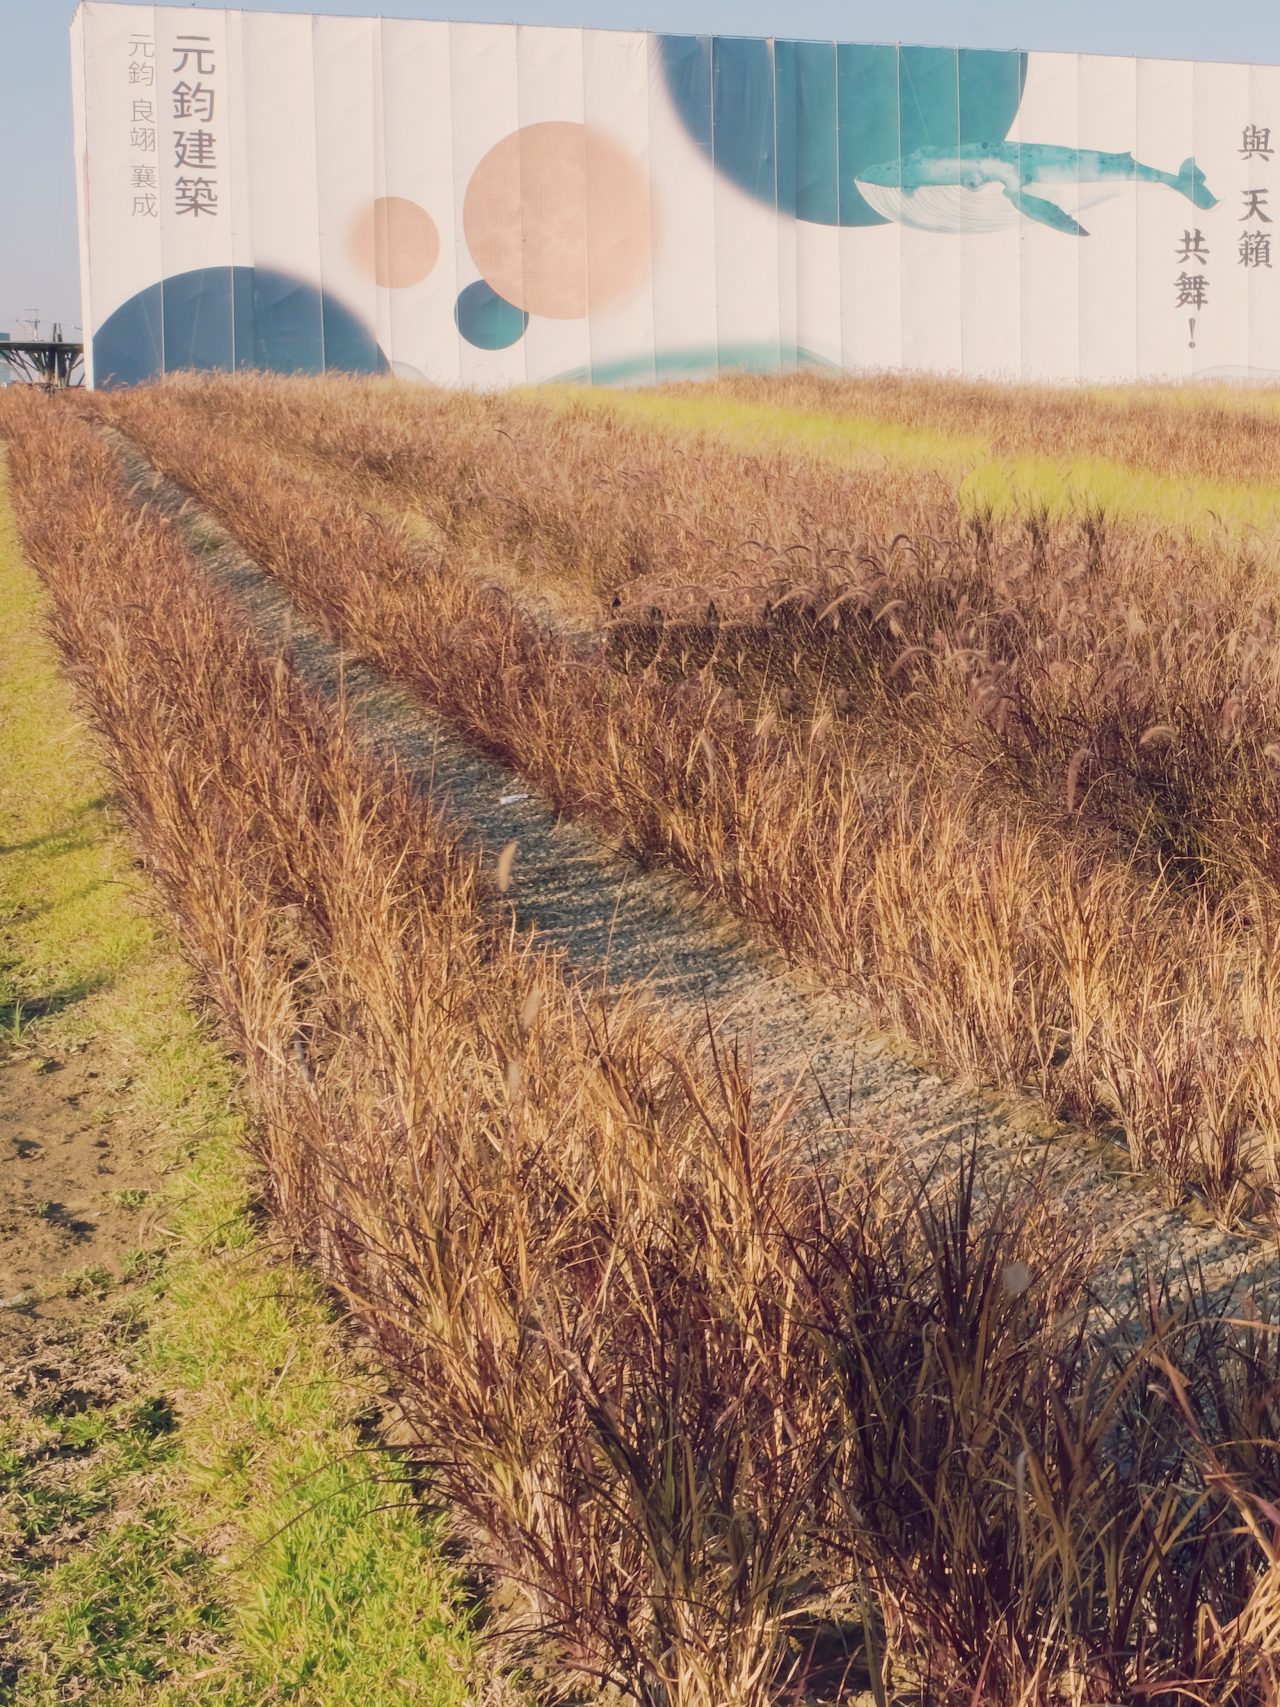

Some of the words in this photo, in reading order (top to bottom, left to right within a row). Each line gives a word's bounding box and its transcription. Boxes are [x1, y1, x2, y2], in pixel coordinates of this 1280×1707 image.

[128, 34, 155, 86] 元鈞
[172, 35, 218, 217] 元鈞建築
[1237, 124, 1275, 162] 與
[1237, 187, 1274, 269] 天籟
